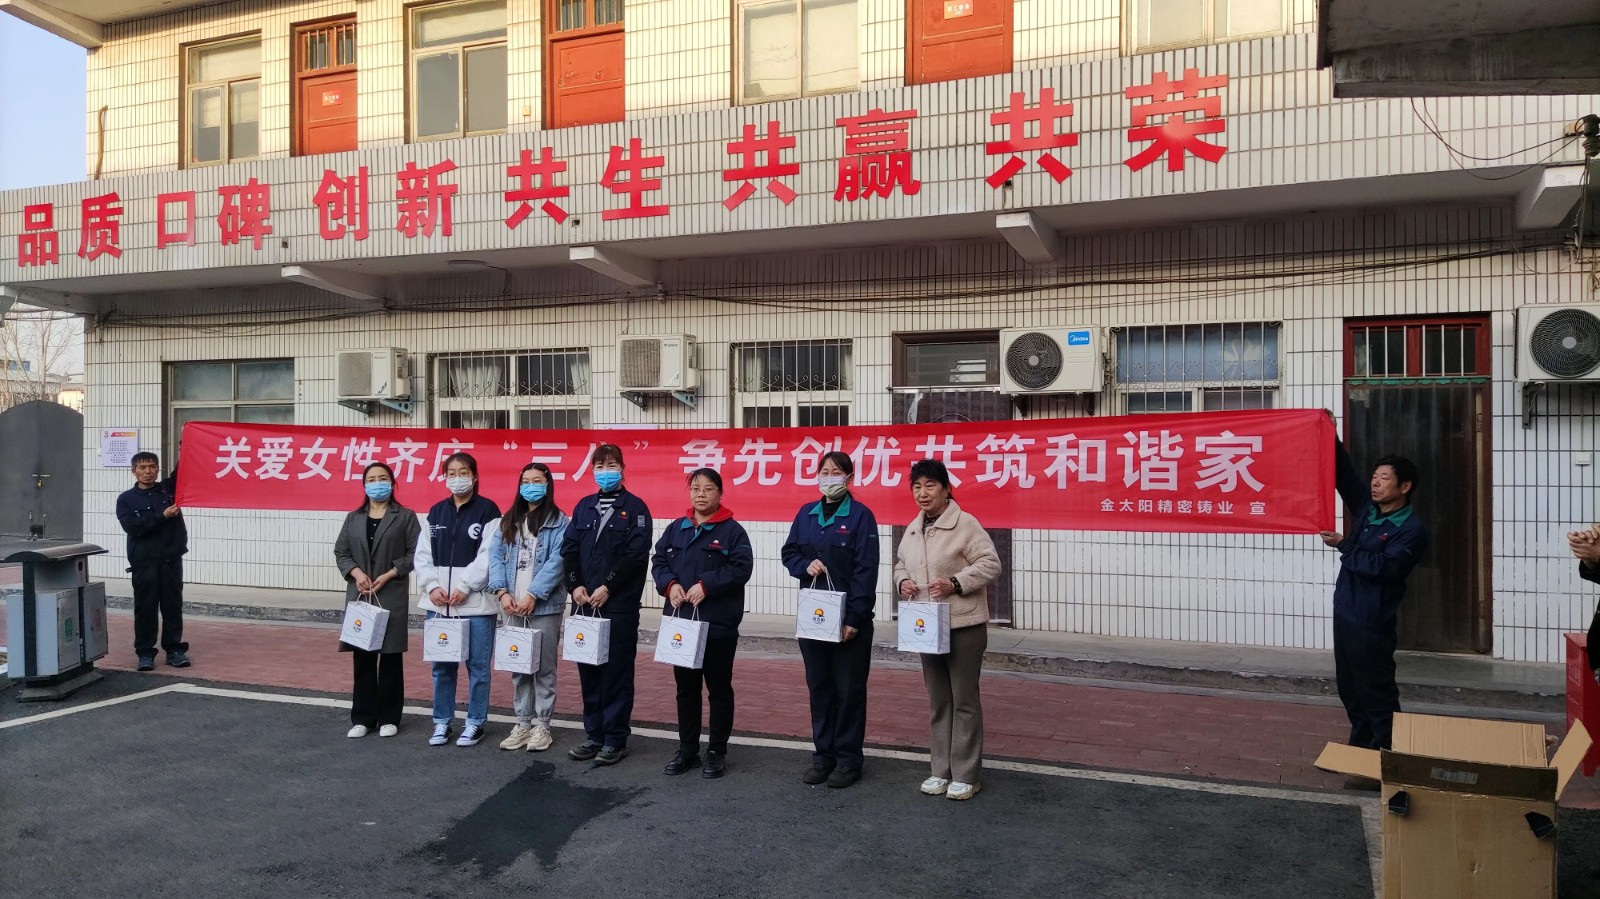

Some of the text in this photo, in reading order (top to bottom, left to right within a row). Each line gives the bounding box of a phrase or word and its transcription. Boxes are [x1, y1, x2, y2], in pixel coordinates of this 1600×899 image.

[18, 68, 1228, 267] 品质 口碑 创新 共生 共赢 共荣
[1100, 499, 1266, 515] 金太阳精密铸业 宣
[473, 526, 480, 537] S
